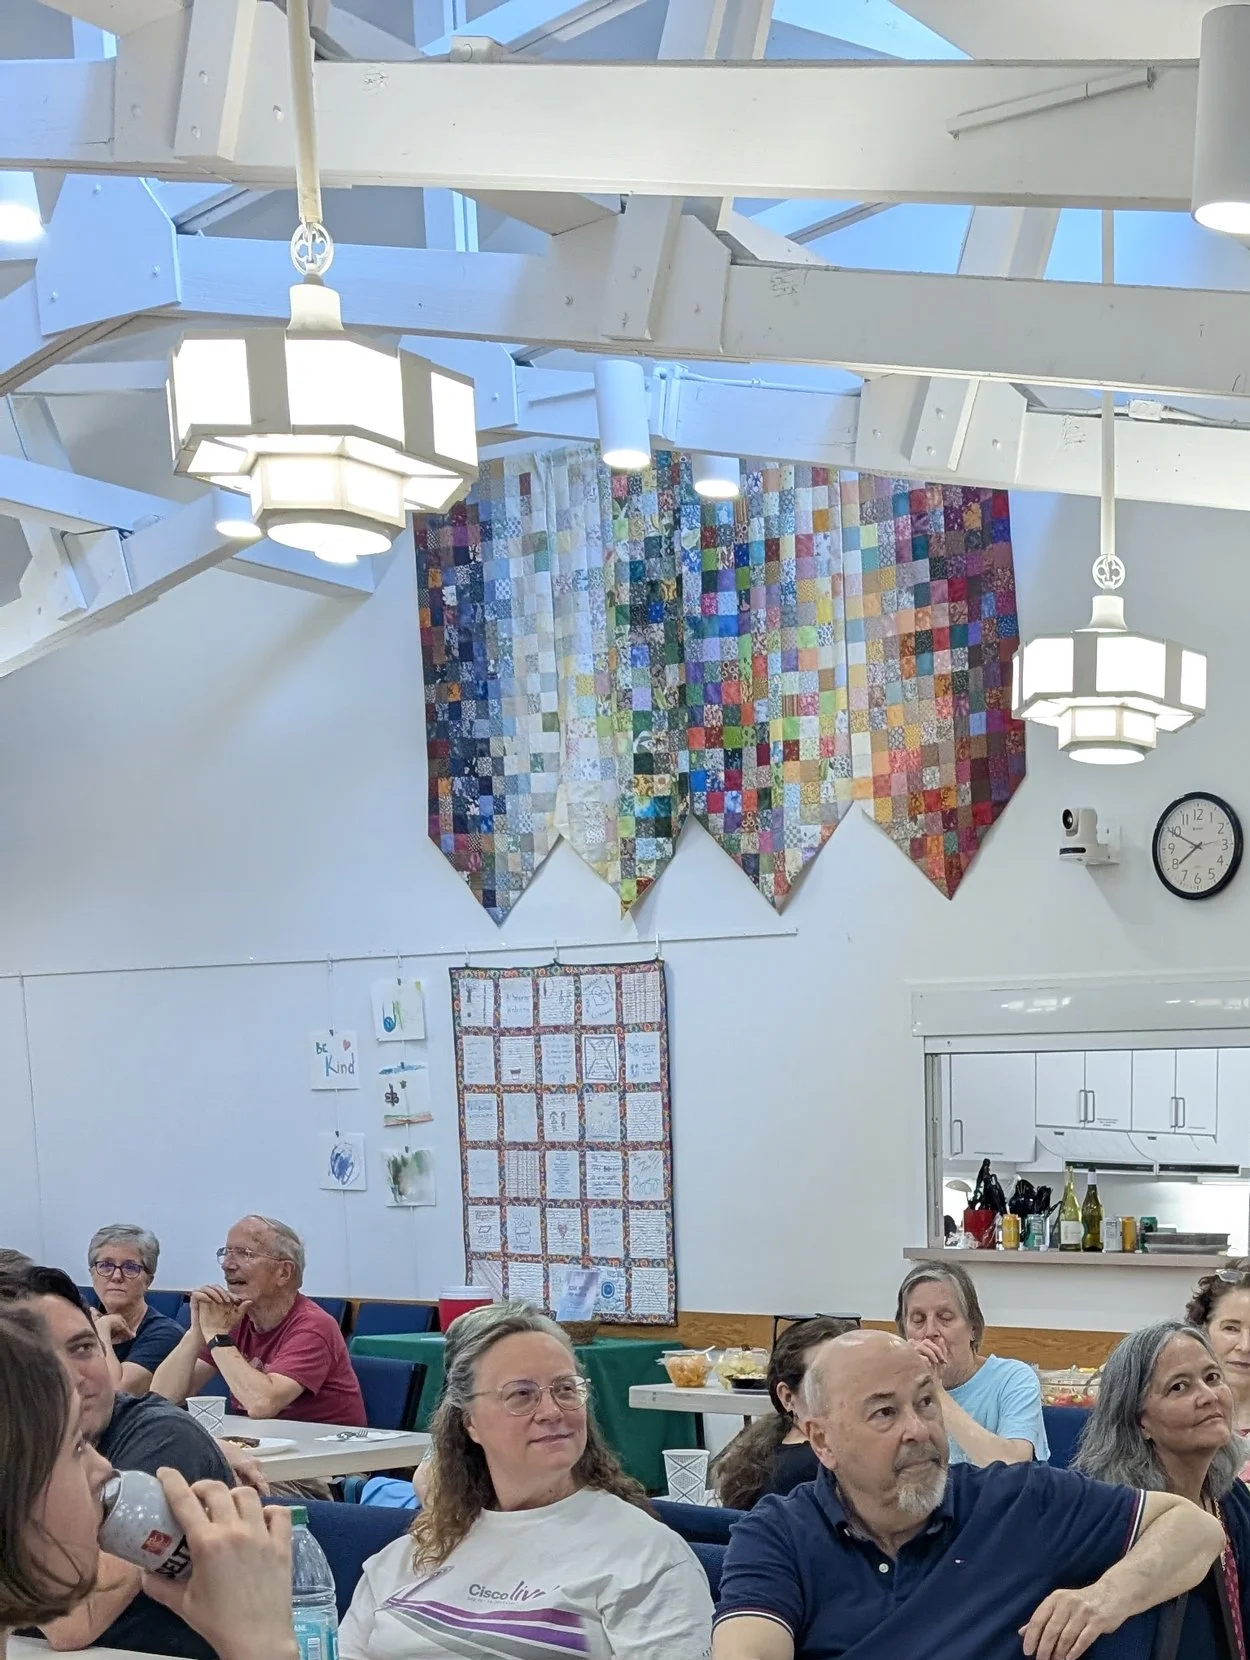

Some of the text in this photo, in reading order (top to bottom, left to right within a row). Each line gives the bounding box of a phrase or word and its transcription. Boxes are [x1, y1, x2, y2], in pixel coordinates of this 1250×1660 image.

[1182, 814, 1189, 825] 11
[1194, 809, 1203, 820] 12
[1171, 825, 1181, 837] 10
[1217, 822, 1225, 834] 2
[1168, 842, 1175, 854] 9
[1221, 838, 1228, 851] 3
[1172, 858, 1179, 870] 8
[1217, 855, 1223, 866] 4
[1181, 869, 1188, 881] 7
[1194, 873, 1201, 884] 6
[1208, 868, 1215, 880] 5
[326, 1052, 355, 1077] Kind
[469, 1583, 509, 1600] Cisco
